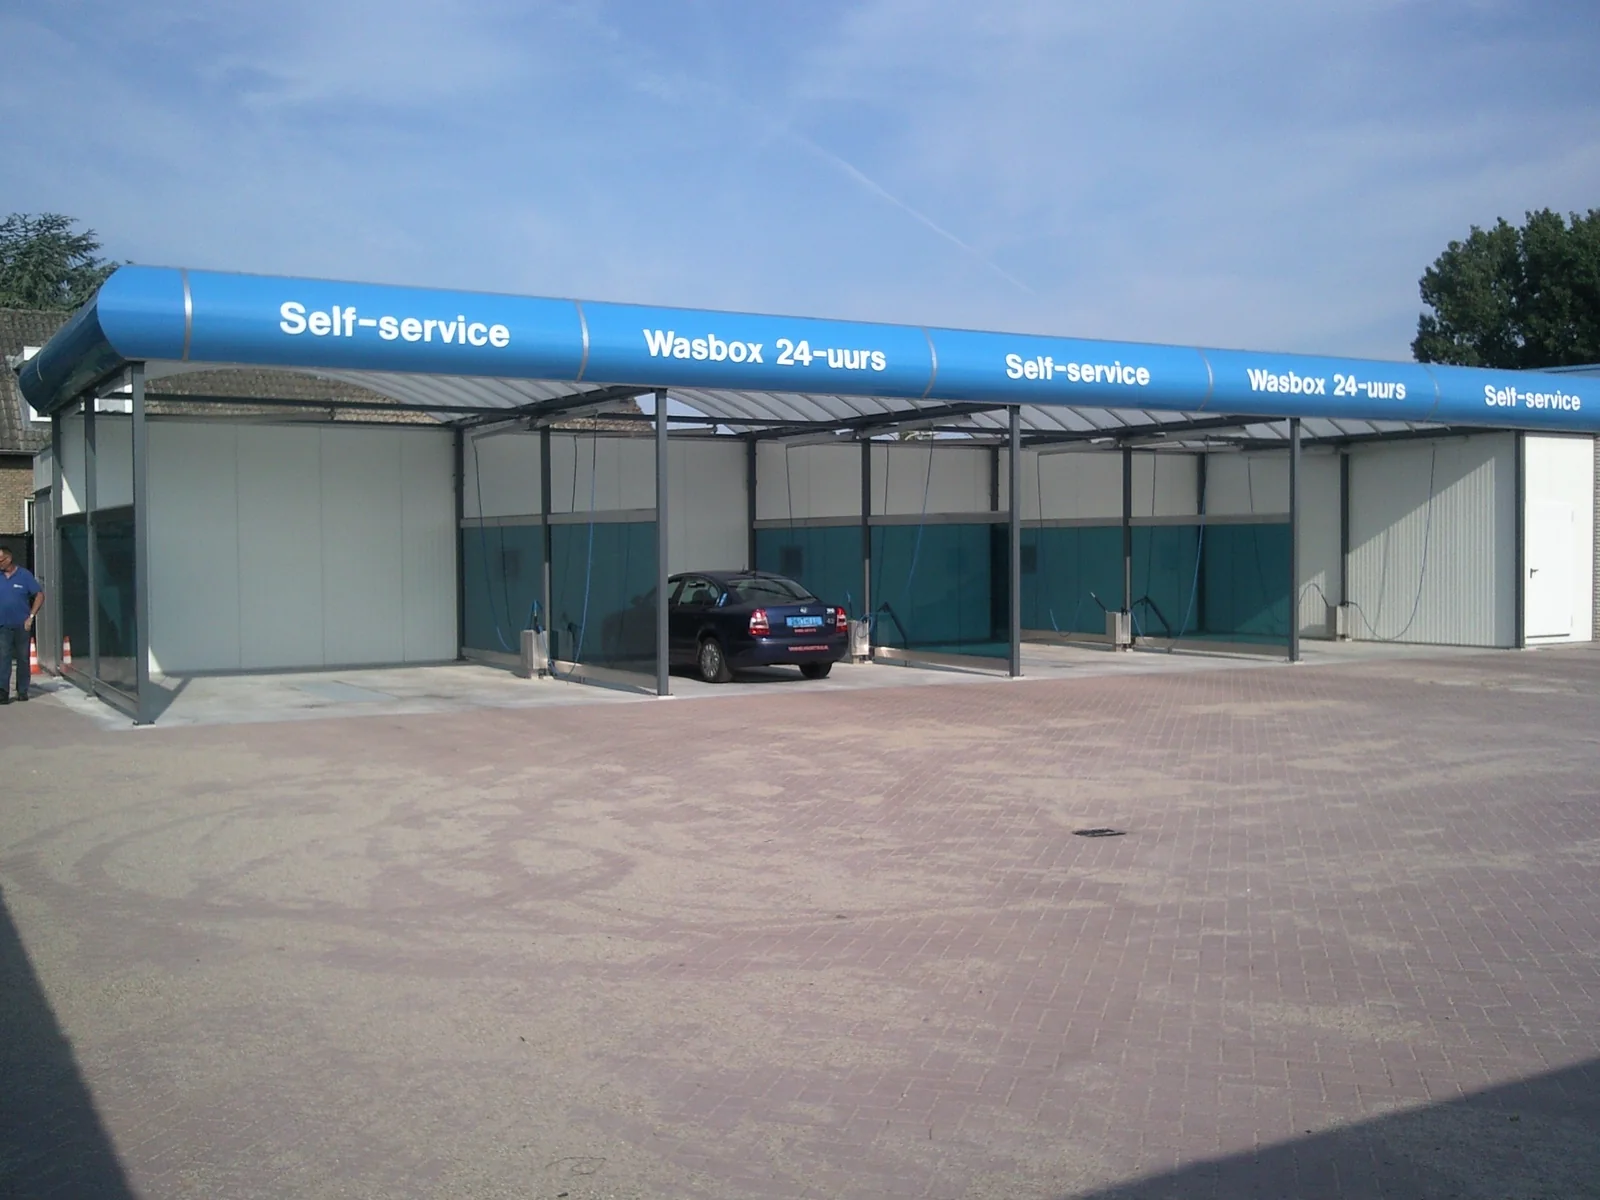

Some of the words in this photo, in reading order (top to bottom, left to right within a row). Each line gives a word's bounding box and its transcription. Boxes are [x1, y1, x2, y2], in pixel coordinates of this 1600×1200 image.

[280, 301, 510, 348] Self-service
[642, 328, 764, 364] Wasbox
[776, 338, 887, 371] 24-uurs
[1005, 353, 1151, 387] Self-service
[1247, 368, 1327, 397] Wasbox
[1333, 373, 1407, 400] 24-uurs
[1485, 384, 1581, 411] Self-service
